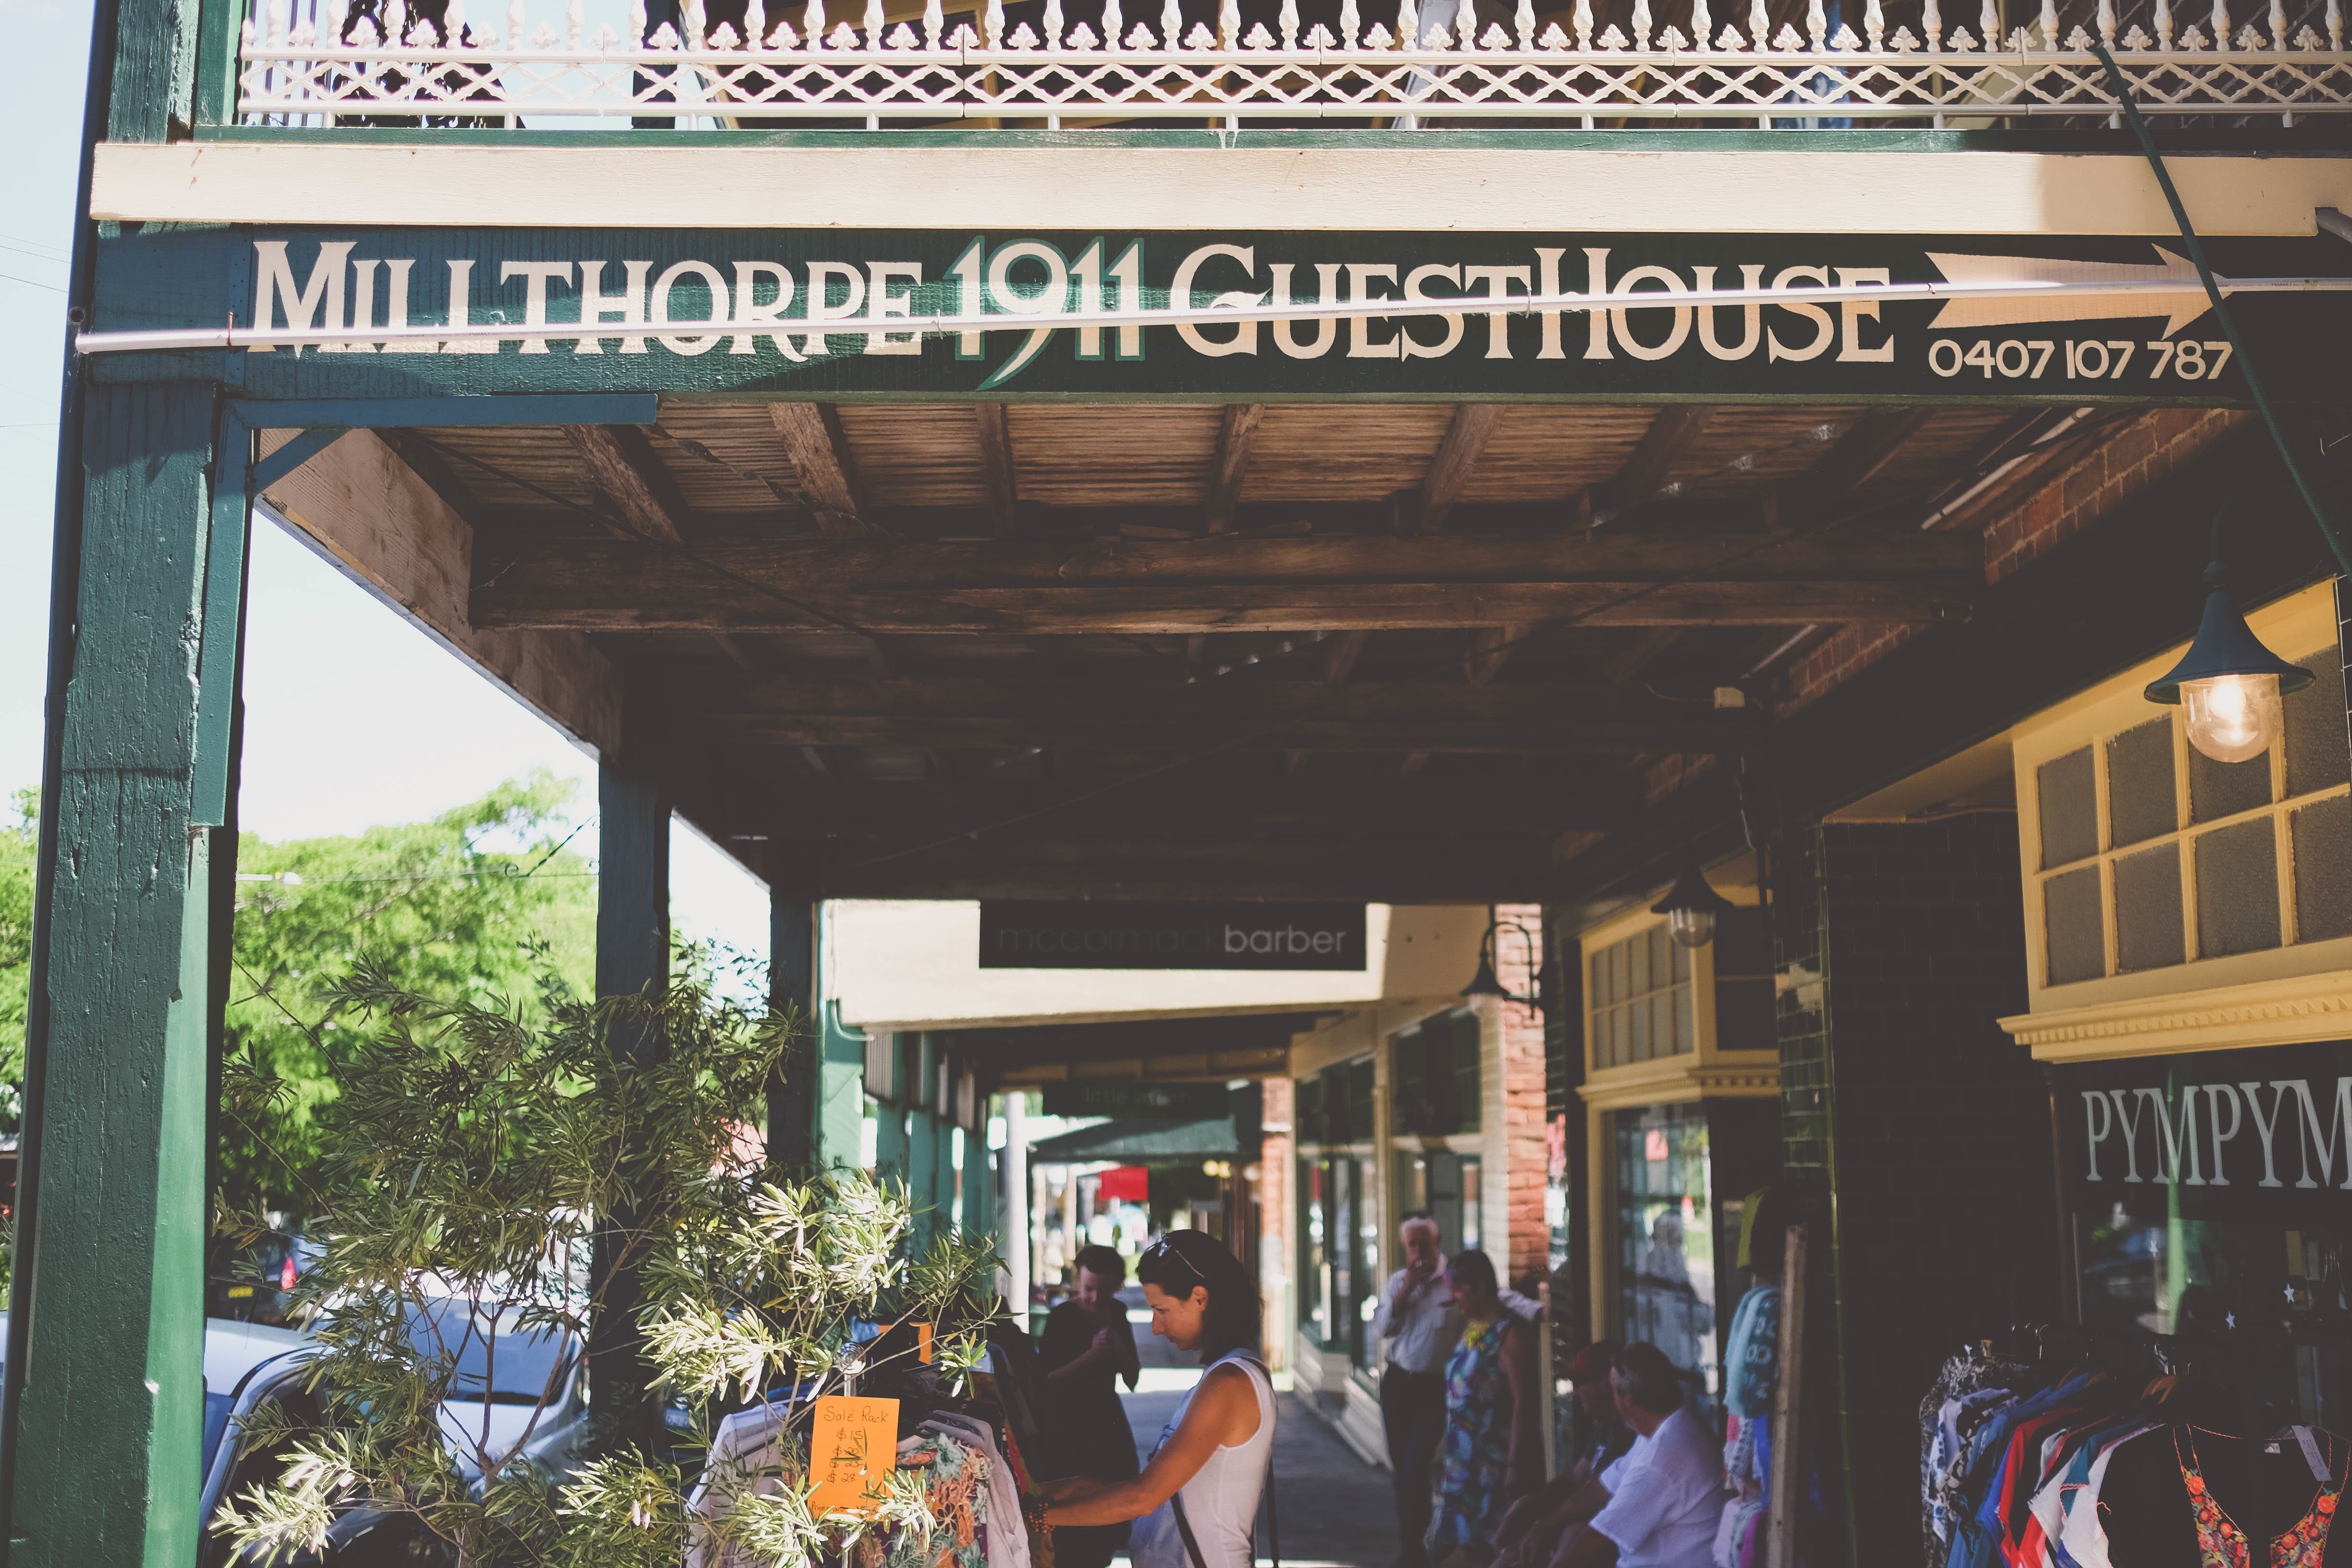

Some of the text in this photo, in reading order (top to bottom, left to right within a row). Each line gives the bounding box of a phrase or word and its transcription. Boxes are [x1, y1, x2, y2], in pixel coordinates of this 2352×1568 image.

[248, 233, 1894, 390] MILLTHORPE 1911 GUESTHOUSE
[1928, 339, 2233, 380] 0407 107 787
[999, 924, 1347, 954] mccormack barber
[823, 1406, 889, 1423] Sale Rack
